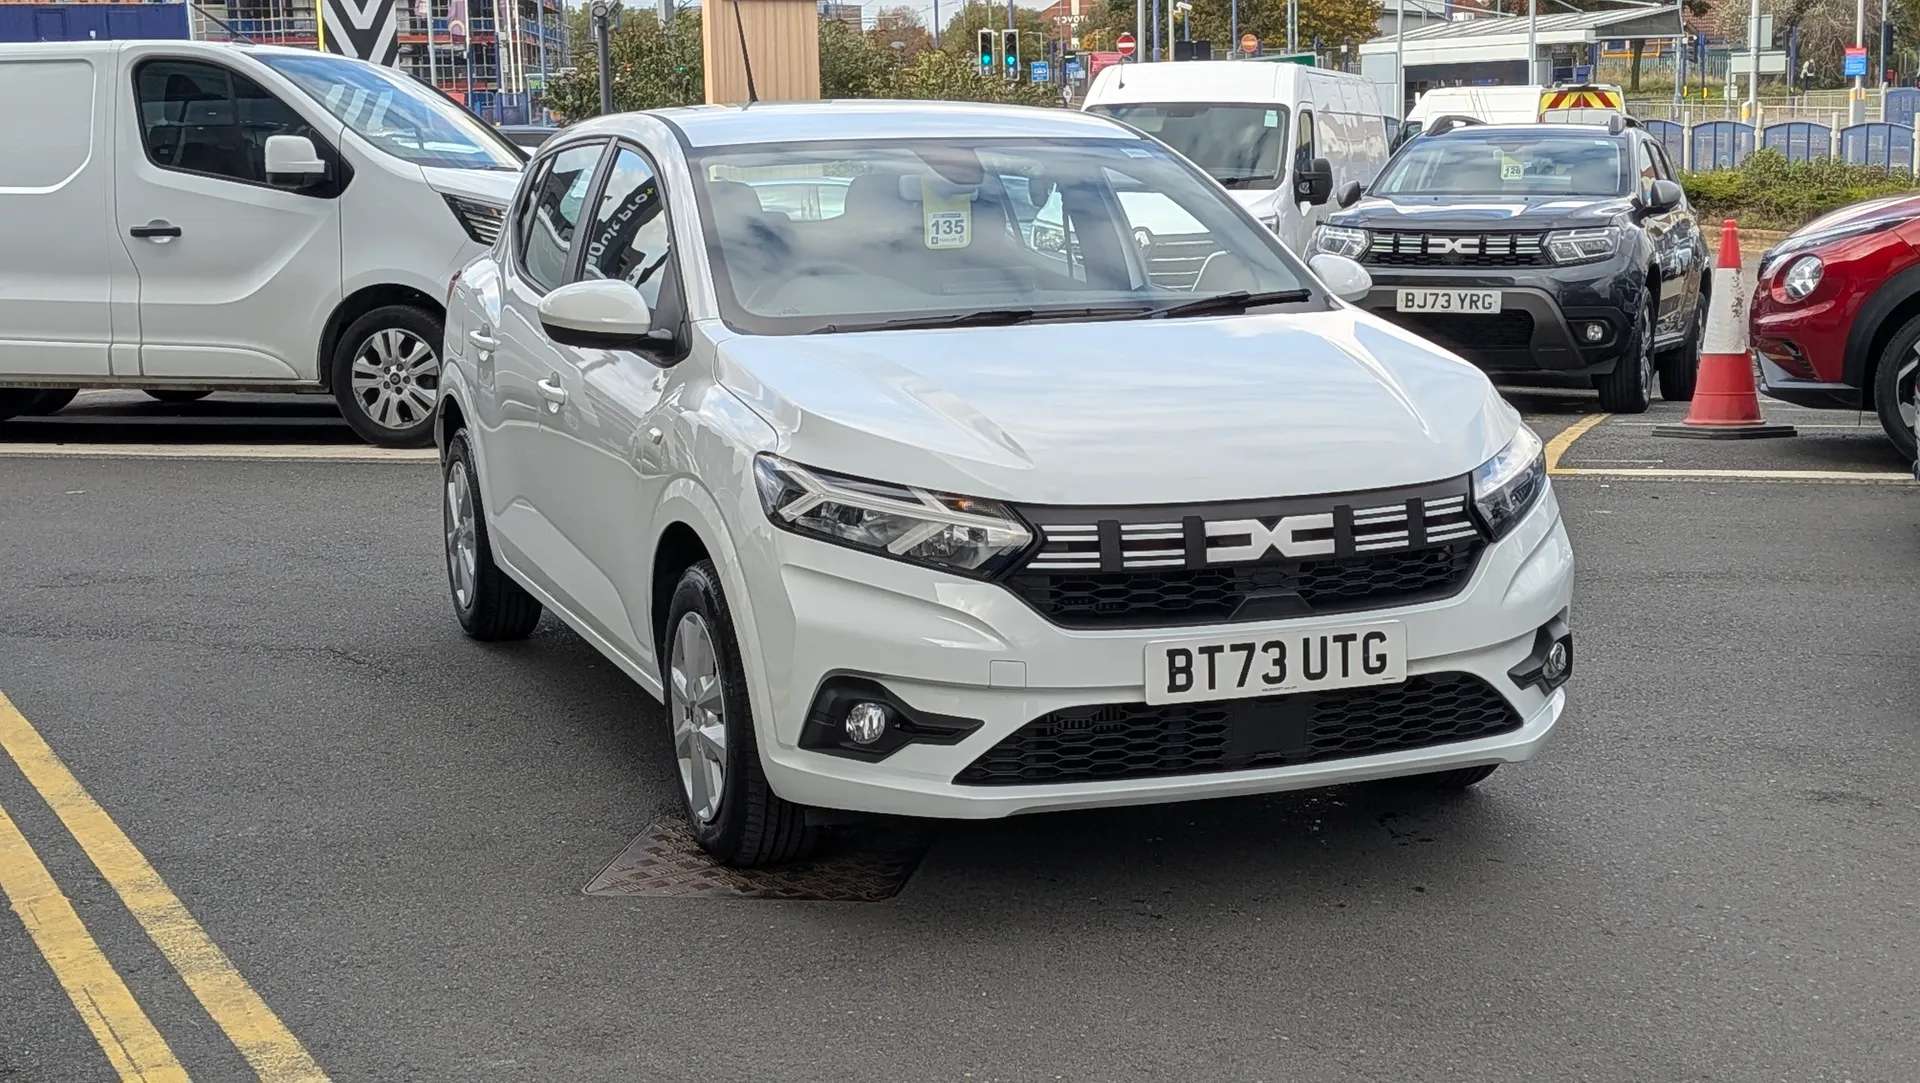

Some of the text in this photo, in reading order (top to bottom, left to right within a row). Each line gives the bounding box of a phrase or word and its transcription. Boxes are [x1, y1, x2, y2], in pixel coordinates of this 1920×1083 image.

[931, 219, 965, 235] 135
[1404, 292, 1493, 310] BJ73 YRG
[1166, 631, 1388, 694] BT73 UTG
